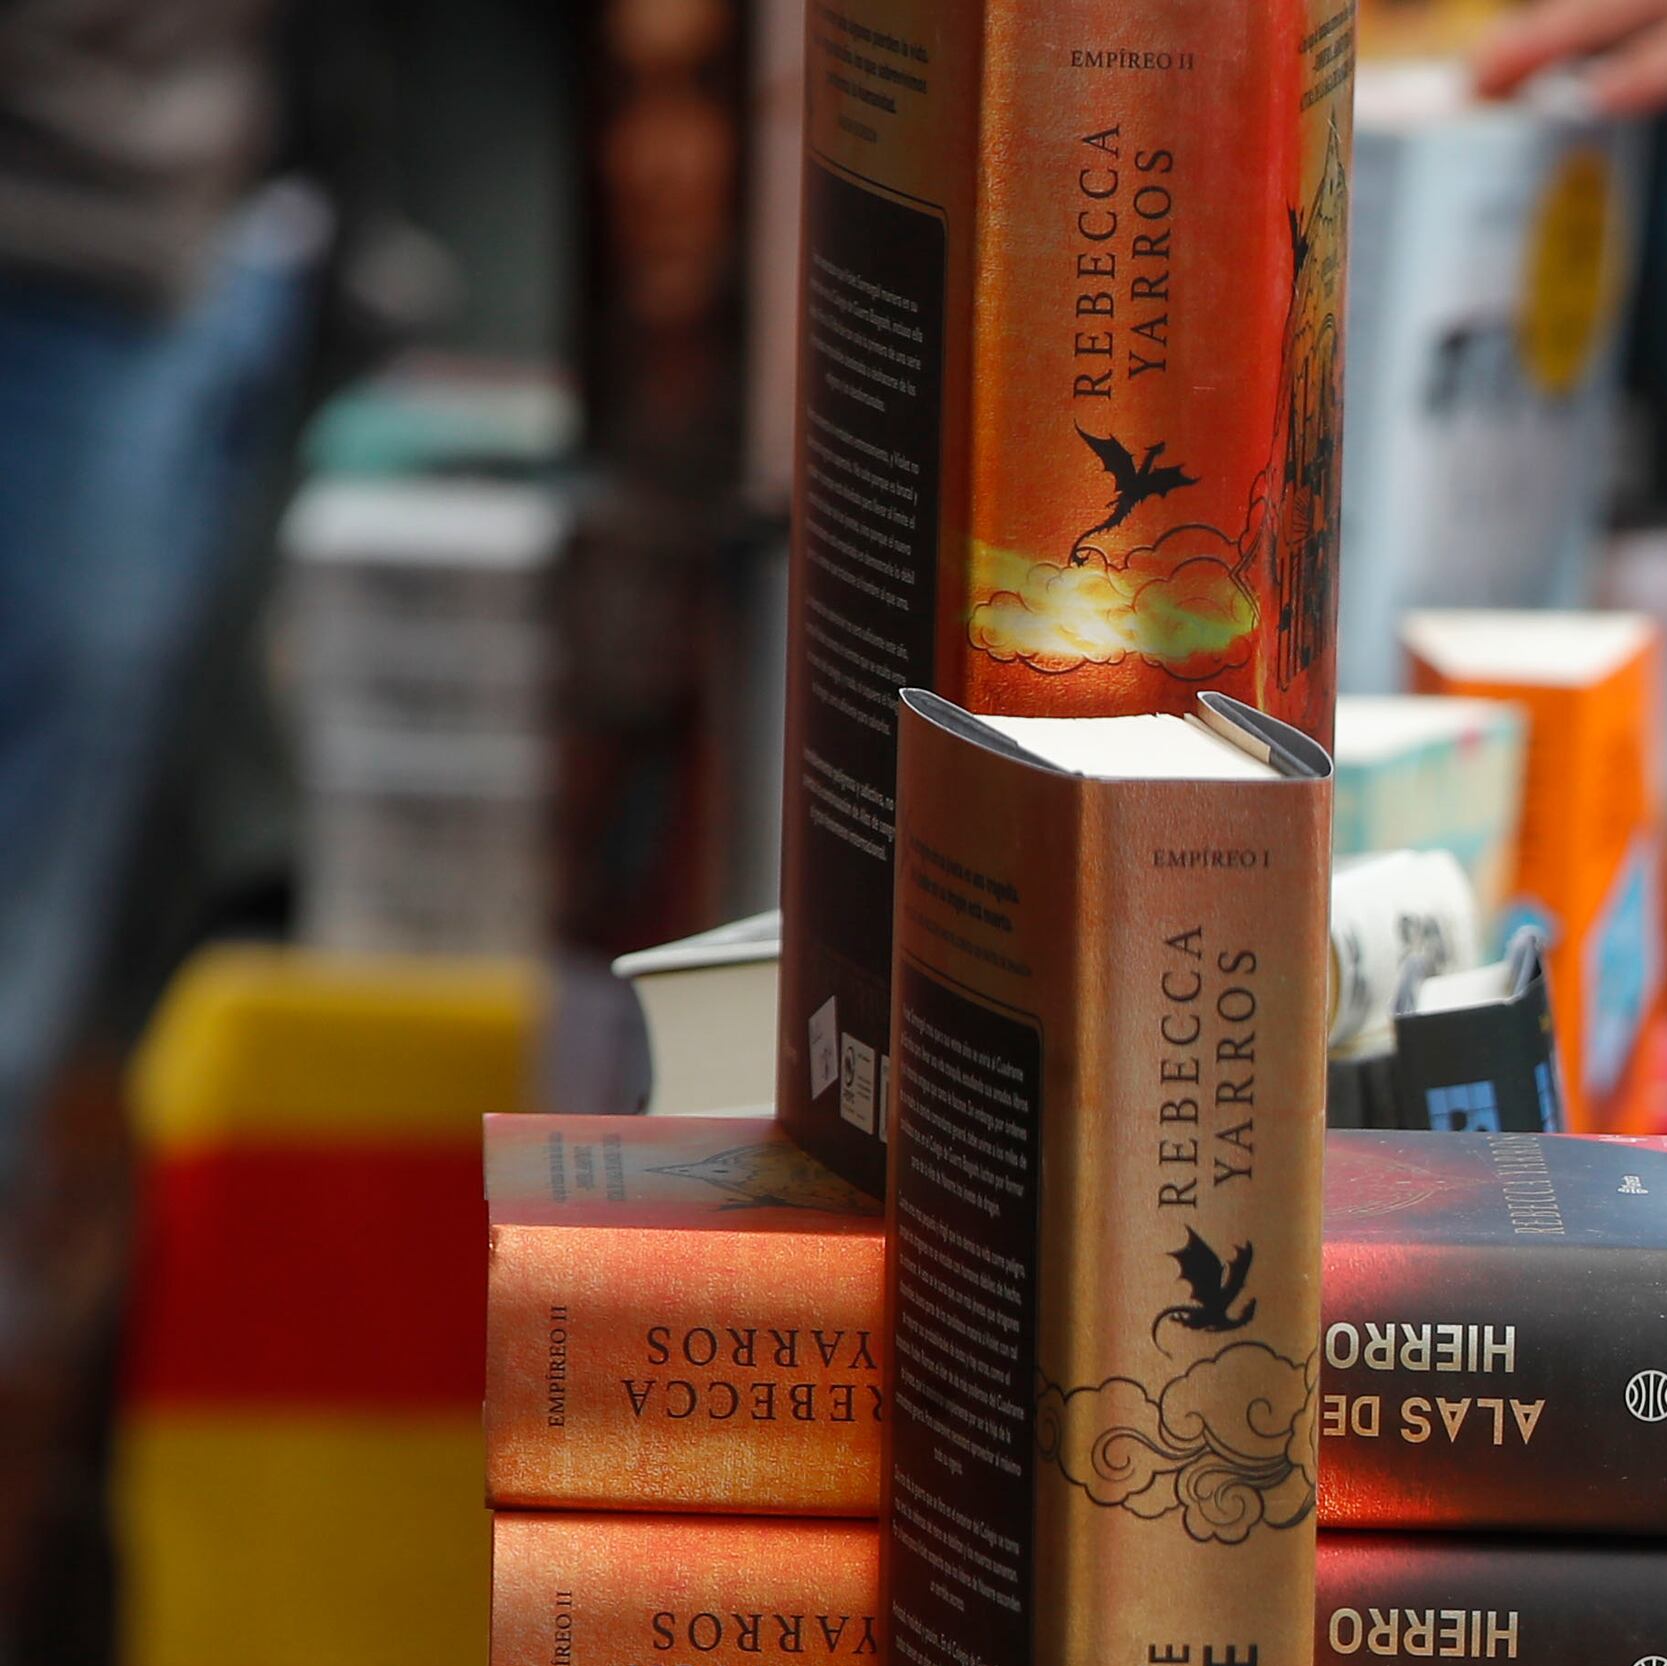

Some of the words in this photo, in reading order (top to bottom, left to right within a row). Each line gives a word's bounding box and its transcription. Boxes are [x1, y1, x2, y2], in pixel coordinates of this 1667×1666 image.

[1071, 49, 1172, 70] EMPÍREO
[1177, 51, 1195, 70] II
[1073, 124, 1121, 400] REBECCA
[1129, 147, 1174, 380] YARROS
[1153, 849, 1257, 869] EMPÍREO
[1261, 850, 1271, 868] I
[1159, 925, 1204, 1209] REBECCA
[1214, 949, 1258, 1189] YARROS
[551, 1305, 568, 1321] II
[647, 1326, 880, 1370] YARROS
[1326, 1322, 1516, 1373] HIERRO
[547, 1328, 568, 1428] EMPÍREO
[1323, 1394, 1380, 1438] DE
[1401, 1396, 1546, 1445] ALAS
[556, 1591, 573, 1608] II
[652, 1611, 878, 1654] YARROS
[1329, 1607, 1519, 1658] HIERRO
